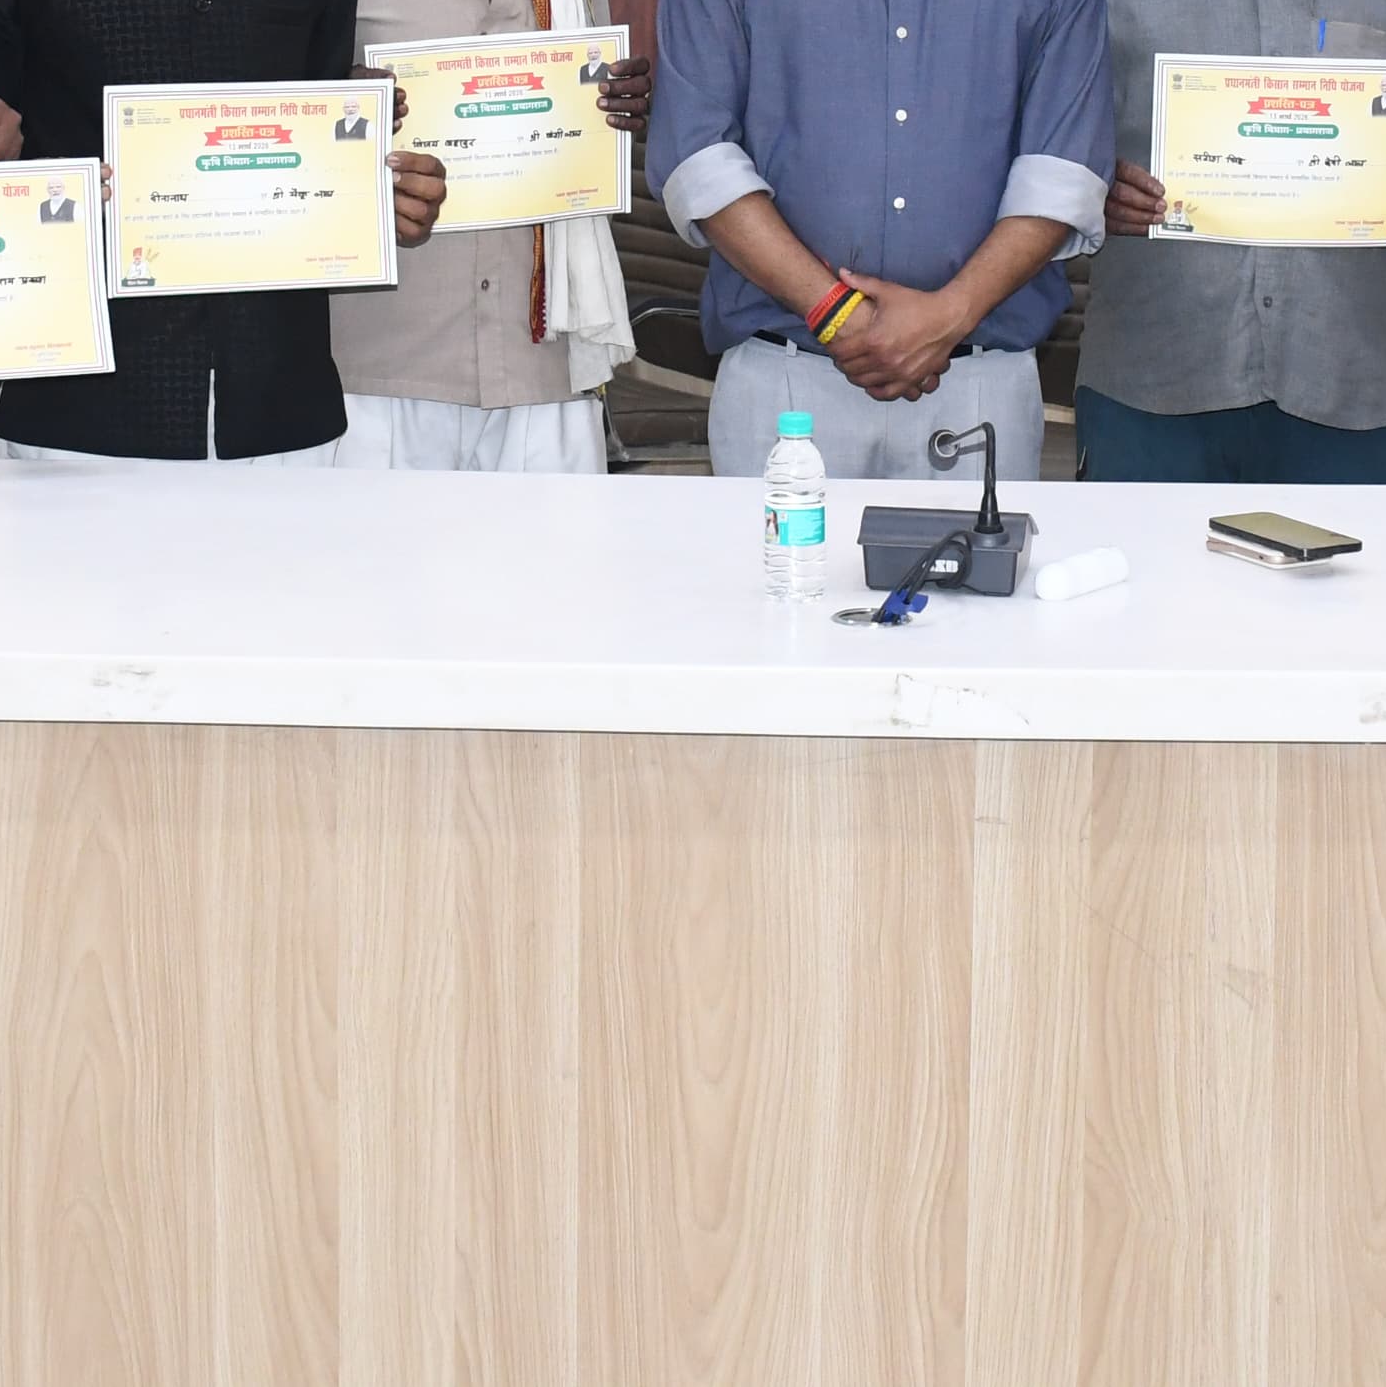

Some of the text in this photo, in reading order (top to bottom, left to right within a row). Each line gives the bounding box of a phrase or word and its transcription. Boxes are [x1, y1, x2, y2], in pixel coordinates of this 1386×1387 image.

[475, 56, 500, 69] किसान
[1264, 77, 1289, 90] किसान
[221, 104, 247, 118] किसान
